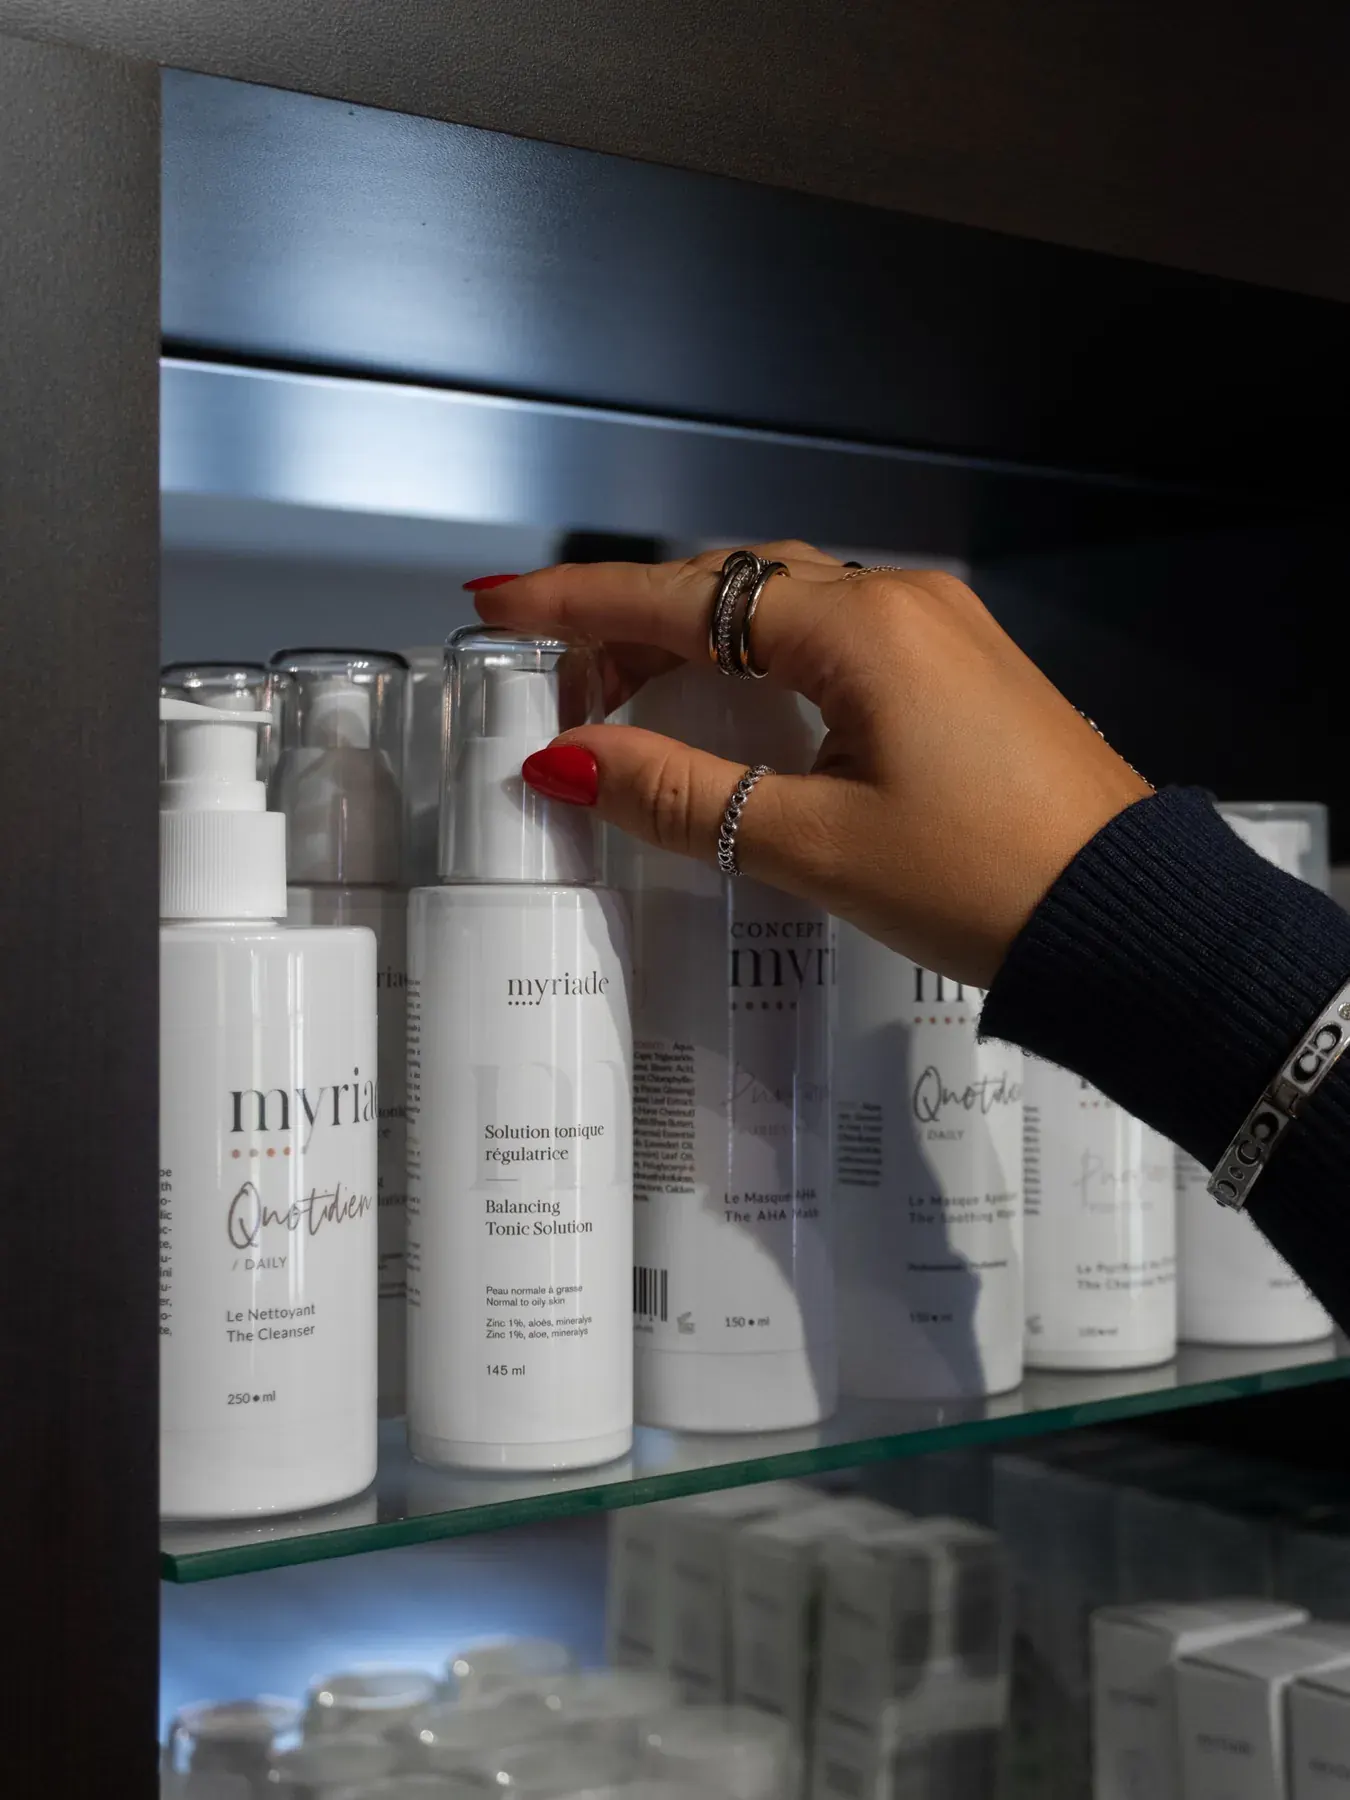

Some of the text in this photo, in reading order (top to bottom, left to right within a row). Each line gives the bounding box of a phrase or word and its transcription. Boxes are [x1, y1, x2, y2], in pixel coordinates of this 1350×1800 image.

[730, 921, 824, 939] CONCEPT
[729, 933, 836, 989] myri
[507, 970, 609, 1006] myriade
[229, 1066, 378, 1156] myria
[484, 1123, 605, 1140] Solution tonique
[485, 1146, 569, 1165] régulatrice
[724, 1192, 740, 1204] Le
[744, 1191, 794, 1206] Masque
[485, 1198, 561, 1217] Balancing
[725, 1209, 752, 1222] The
[757, 1207, 788, 1222] AHA
[485, 1219, 593, 1236] Tonic Solution
[245, 1256, 287, 1271] DAILY
[486, 1286, 509, 1296] Peau
[511, 1285, 546, 1296] normale
[556, 1284, 583, 1296] grasse
[486, 1296, 566, 1309] Normal to oily skin
[227, 1303, 316, 1322] Le Nettoyant
[486, 1318, 506, 1328] Zinc
[227, 1324, 315, 1343] The Cleanser
[486, 1330, 506, 1340] Zinc
[486, 1364, 526, 1377] 145 ml
